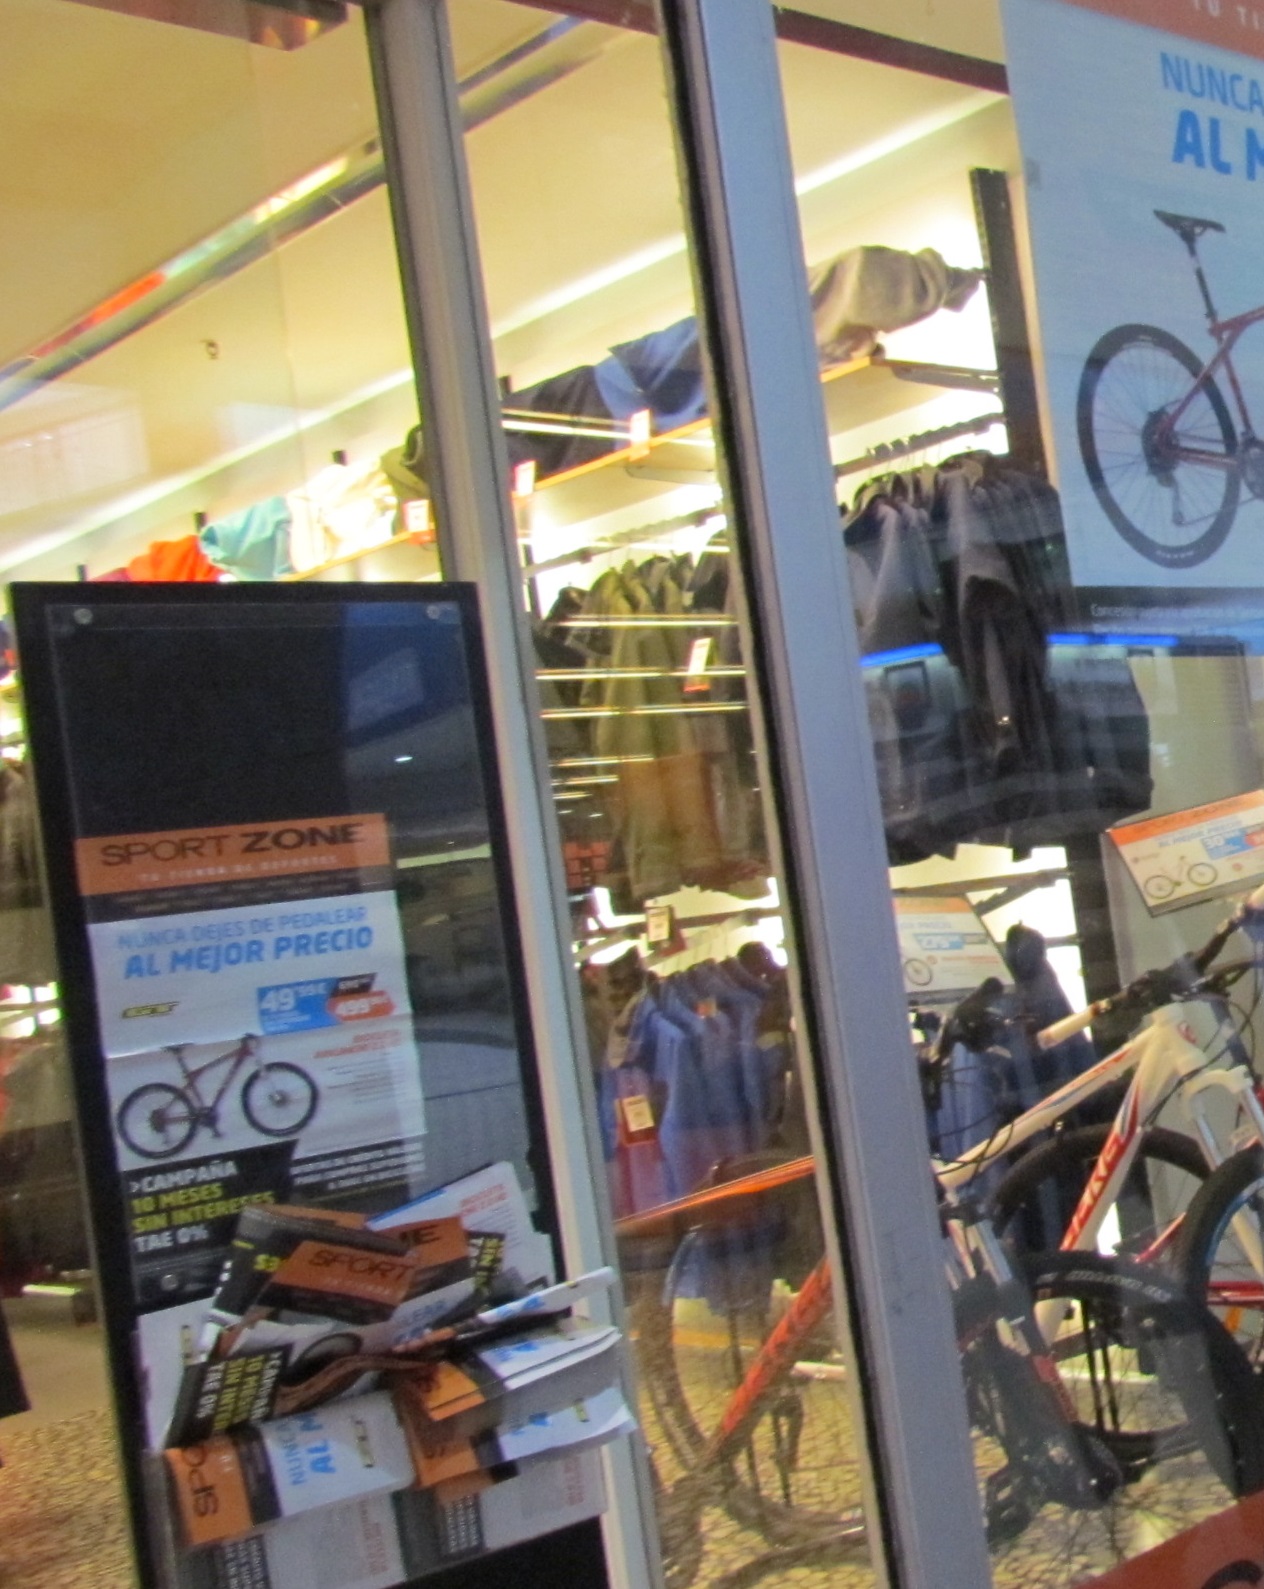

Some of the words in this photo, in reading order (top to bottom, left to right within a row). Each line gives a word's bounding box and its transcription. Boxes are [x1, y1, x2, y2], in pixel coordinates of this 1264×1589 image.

[1171, 109, 1232, 176] AL
[100, 834, 229, 867] SPORT
[240, 822, 366, 854] ZONE
[117, 927, 187, 950] NUNCA
[191, 918, 244, 942] DEJES
[252, 916, 273, 935] DE
[279, 906, 369, 930] PEDALEAR
[124, 954, 161, 980] AL
[169, 938, 265, 973] MEJOR
[273, 925, 374, 960] PRECIO
[158, 1181, 224, 1210] MESES
[133, 1229, 173, 1252] TAE
[309, 1249, 417, 1284] SPORT
